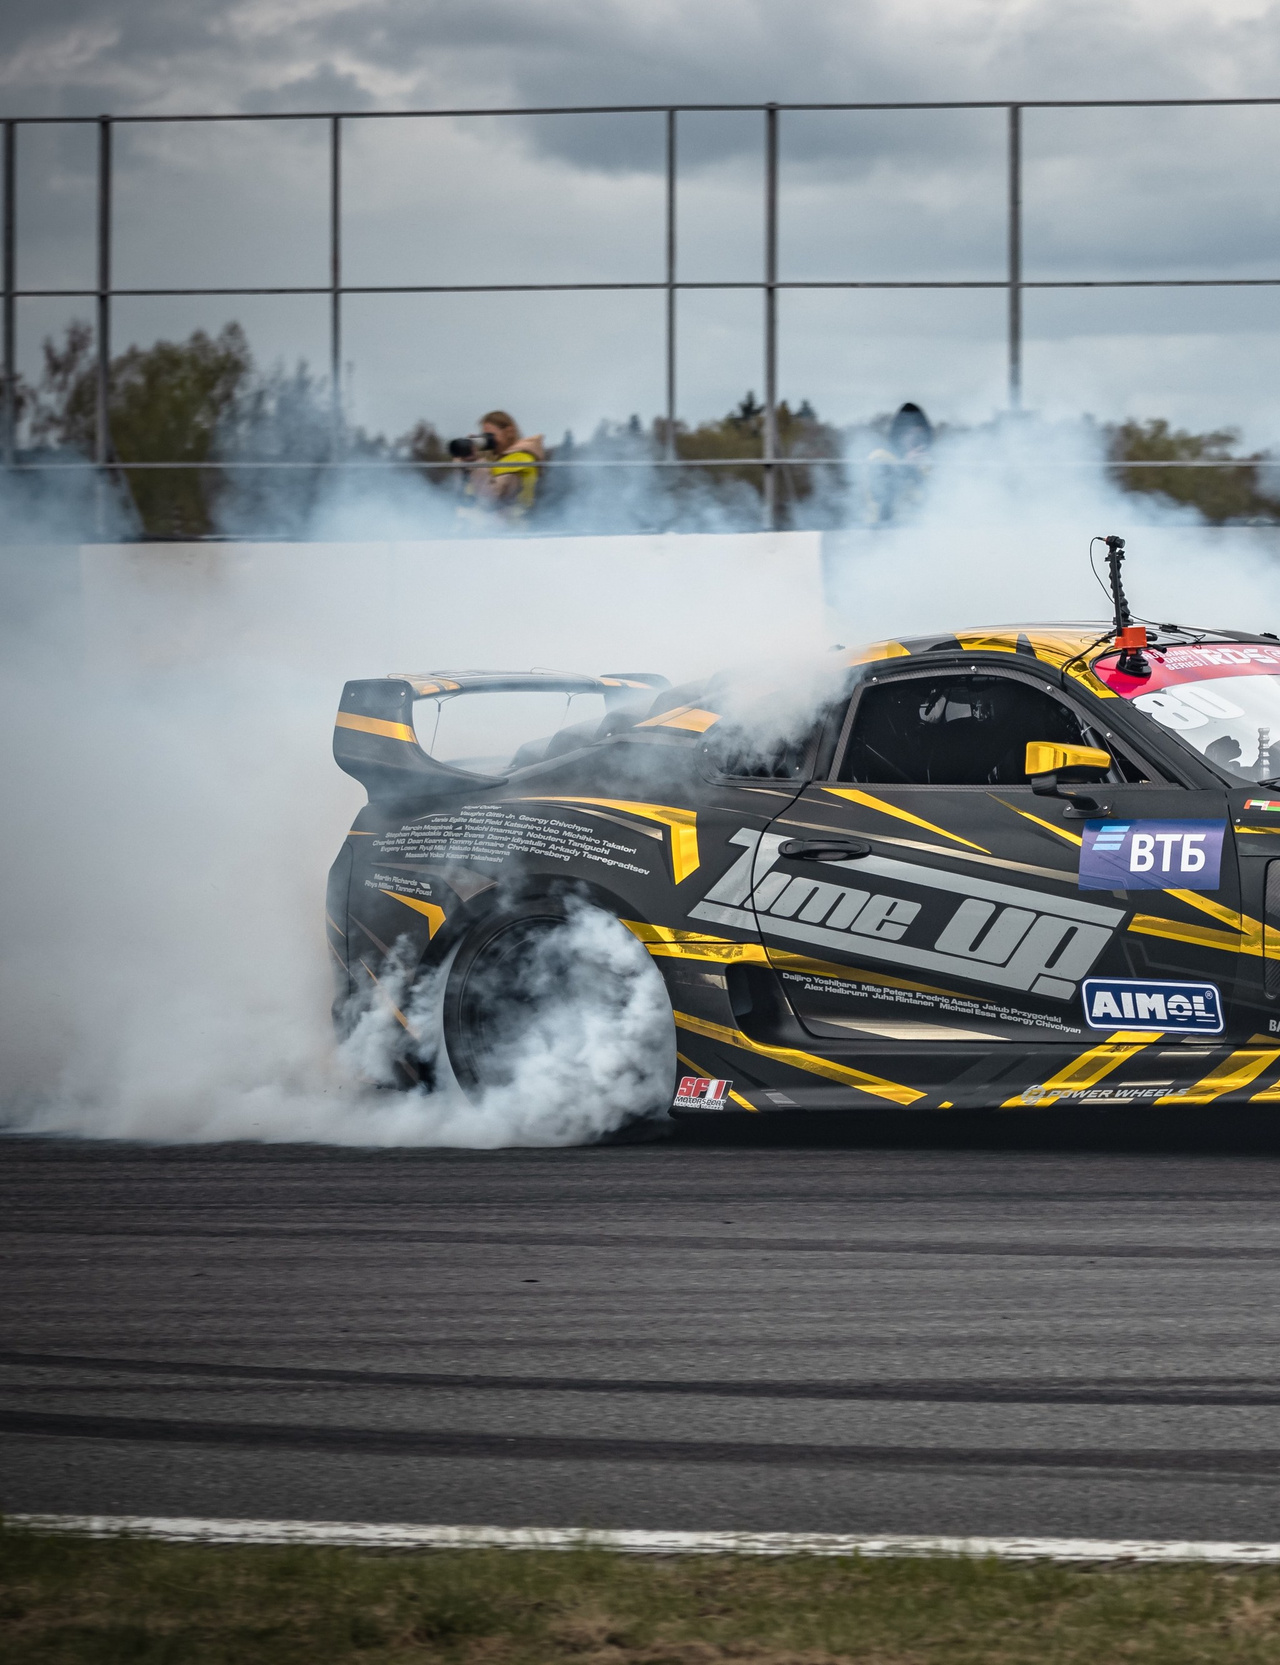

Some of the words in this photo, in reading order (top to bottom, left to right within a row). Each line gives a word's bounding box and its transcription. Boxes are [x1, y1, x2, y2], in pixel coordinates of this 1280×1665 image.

[1163, 655, 1194, 664] DRIFT
[1165, 660, 1203, 671] SERIES
[1132, 686, 1245, 730] 80
[460, 810, 486, 819] Vaughn
[519, 814, 549, 825] Georgy
[550, 819, 593, 834] Chivchyan
[485, 818, 502, 826] Field
[504, 820, 542, 832] Katsuhiro
[543, 824, 559, 835] Ueo
[562, 830, 600, 845] Michihiro
[602, 839, 637, 854] Takatori
[526, 831, 566, 845] Nobuteru
[567, 839, 610, 856] Taniguchi
[507, 843, 529, 853] Chris
[529, 844, 570, 862] Forsberg
[548, 842, 581, 857] Arkady
[581, 851, 650, 876] Tsaregradtsev
[1128, 833, 1206, 873] ВТБ
[415, 887, 433, 897] Foust
[782, 972, 812, 983] Daijiro
[813, 976, 857, 990] Yoshihara
[861, 983, 883, 994] Mike
[883, 986, 914, 999] Peters
[916, 991, 950, 1004] Fredric
[982, 1003, 1010, 1014] Jakub
[804, 983, 824, 993] Alex
[825, 985, 869, 998] Heilbrunn
[871, 993, 895, 1003] Juha
[895, 996, 935, 1008] Rintanen
[939, 1002, 974, 1015] Michael
[975, 1008, 997, 1019] Essa
[1000, 1012, 1035, 1026] Georgy
[1035, 1019, 1082, 1035] Chivchyan
[1092, 991, 1216, 1022] AIMOL
[675, 1095, 727, 1106] MOTORSPORT
[1046, 1089, 1114, 1099] POWER
[1115, 1087, 1191, 1099] WHEELS
